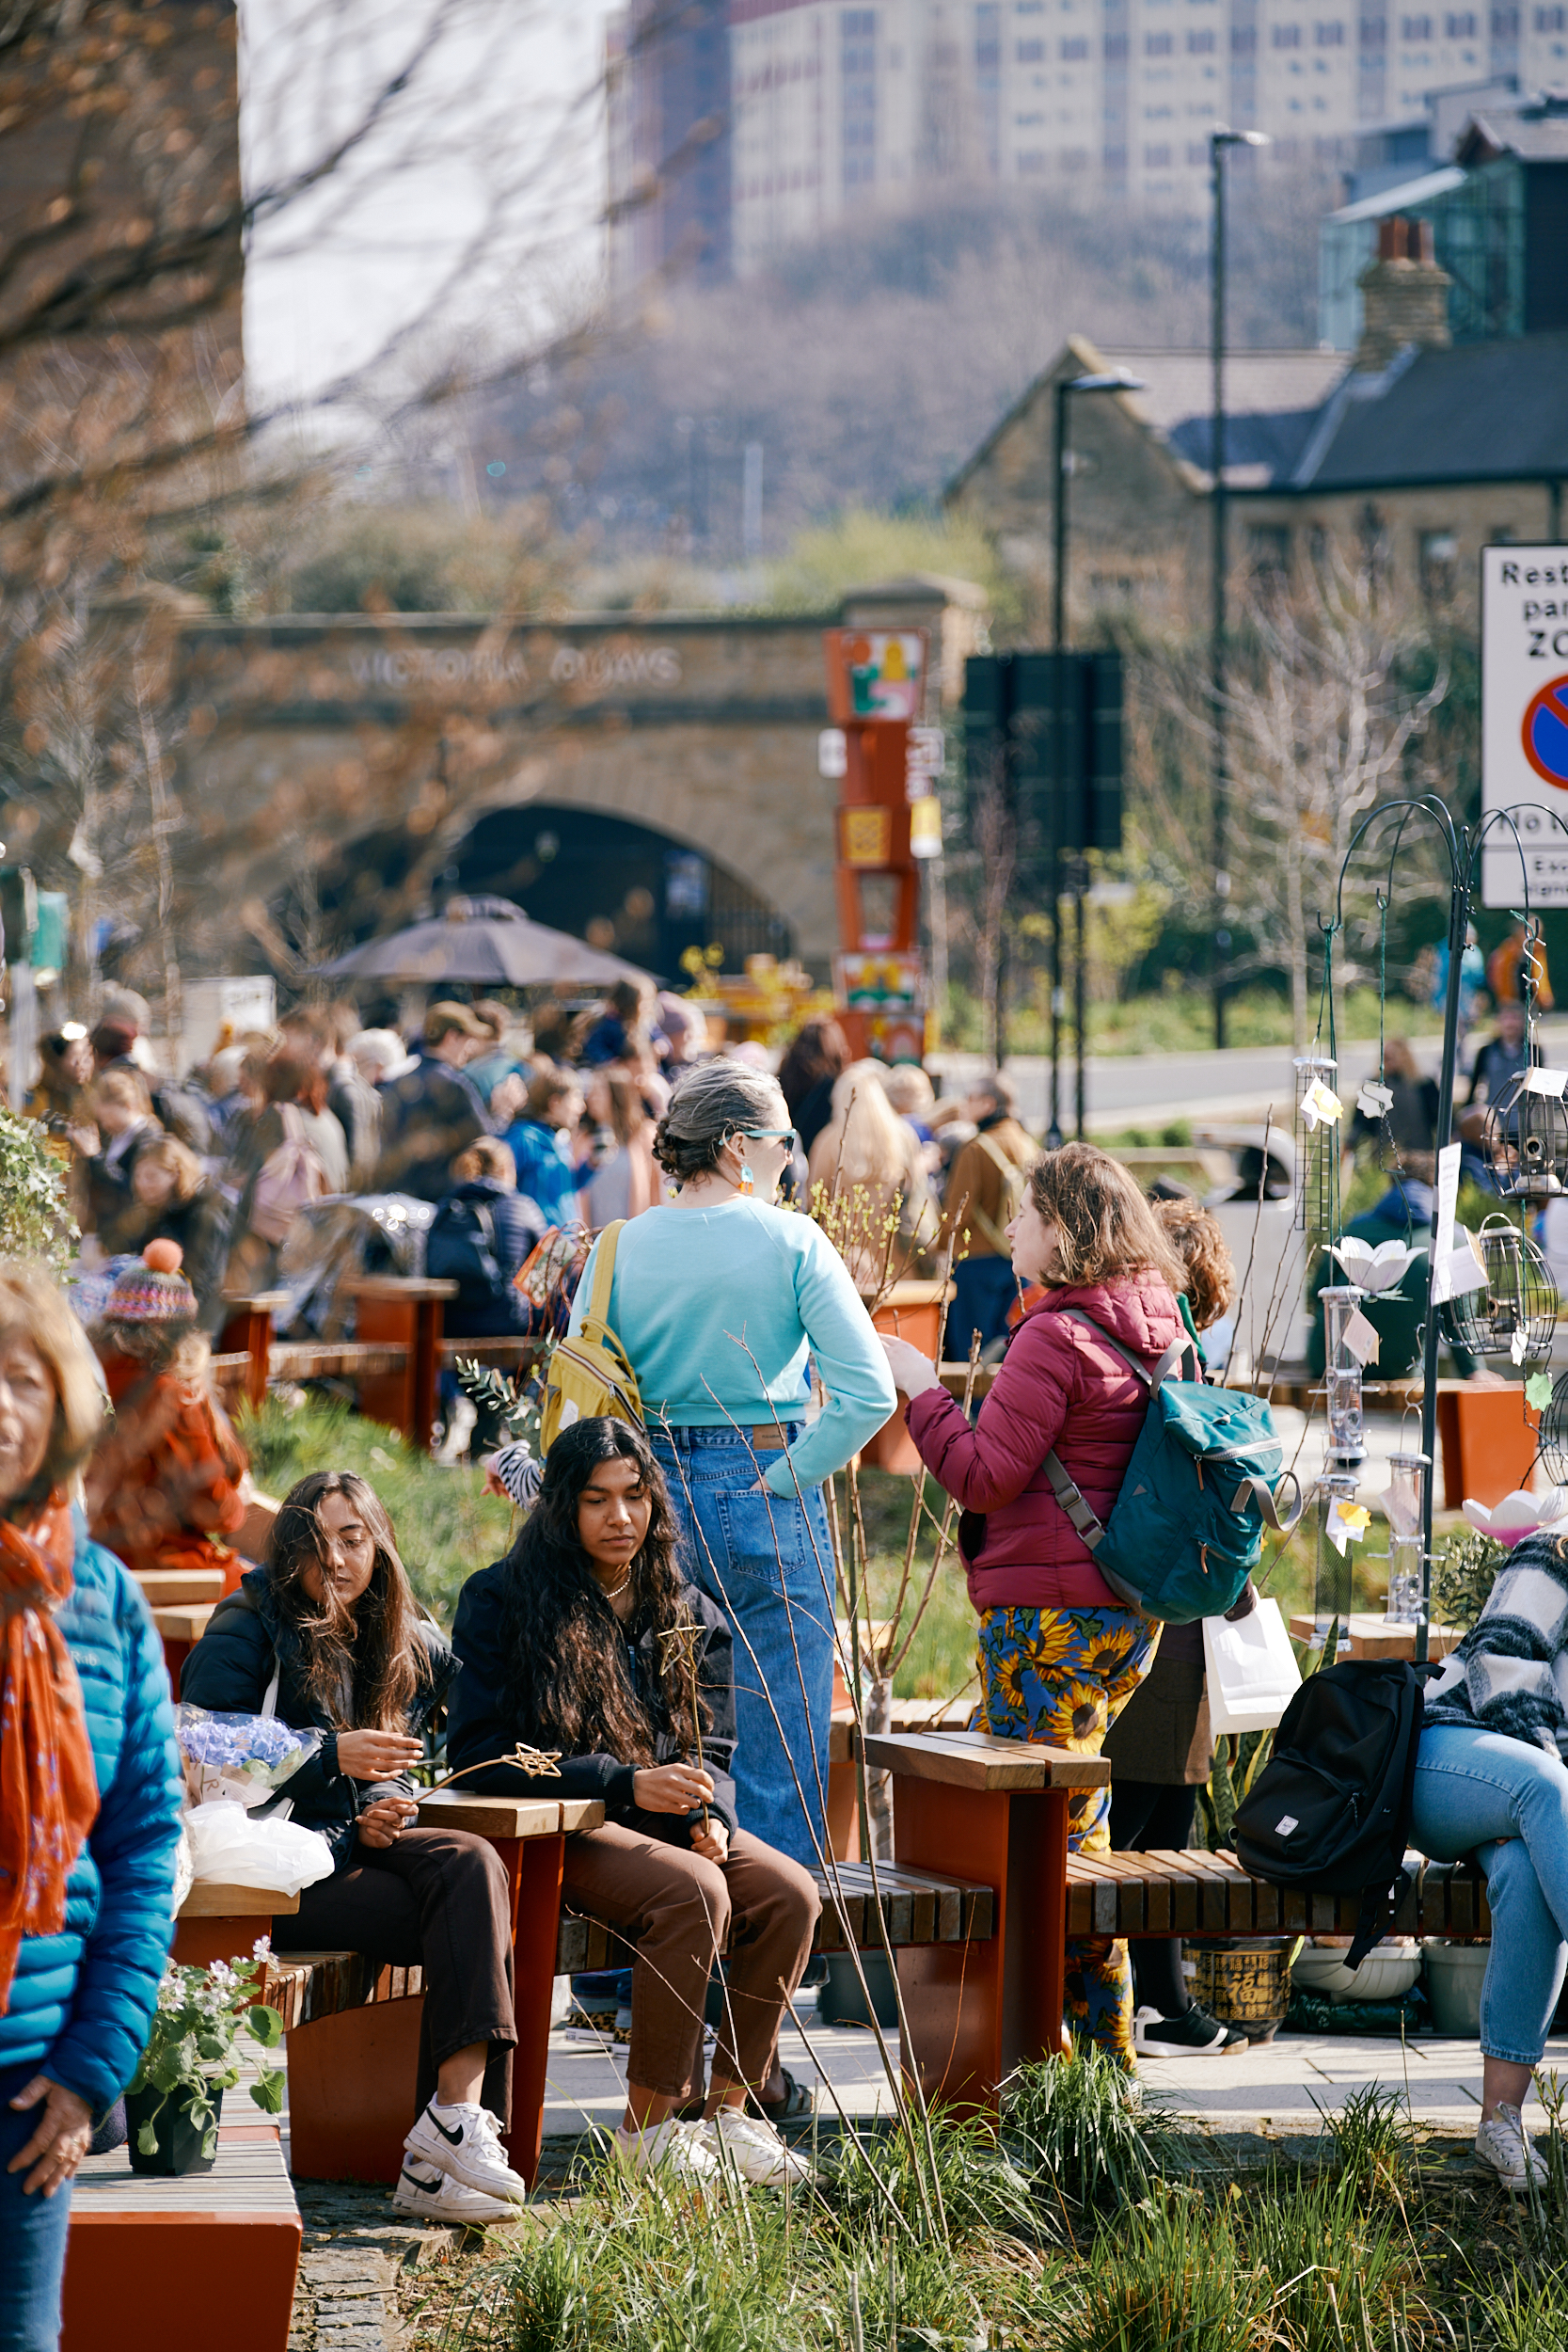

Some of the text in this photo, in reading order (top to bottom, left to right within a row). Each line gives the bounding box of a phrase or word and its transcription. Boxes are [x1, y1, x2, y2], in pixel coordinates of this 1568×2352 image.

[1501, 562, 1568, 585] Rest
[1524, 600, 1568, 623] par
[1498, 808, 1540, 832] No
[71, 1650, 98, 1666] Rab
